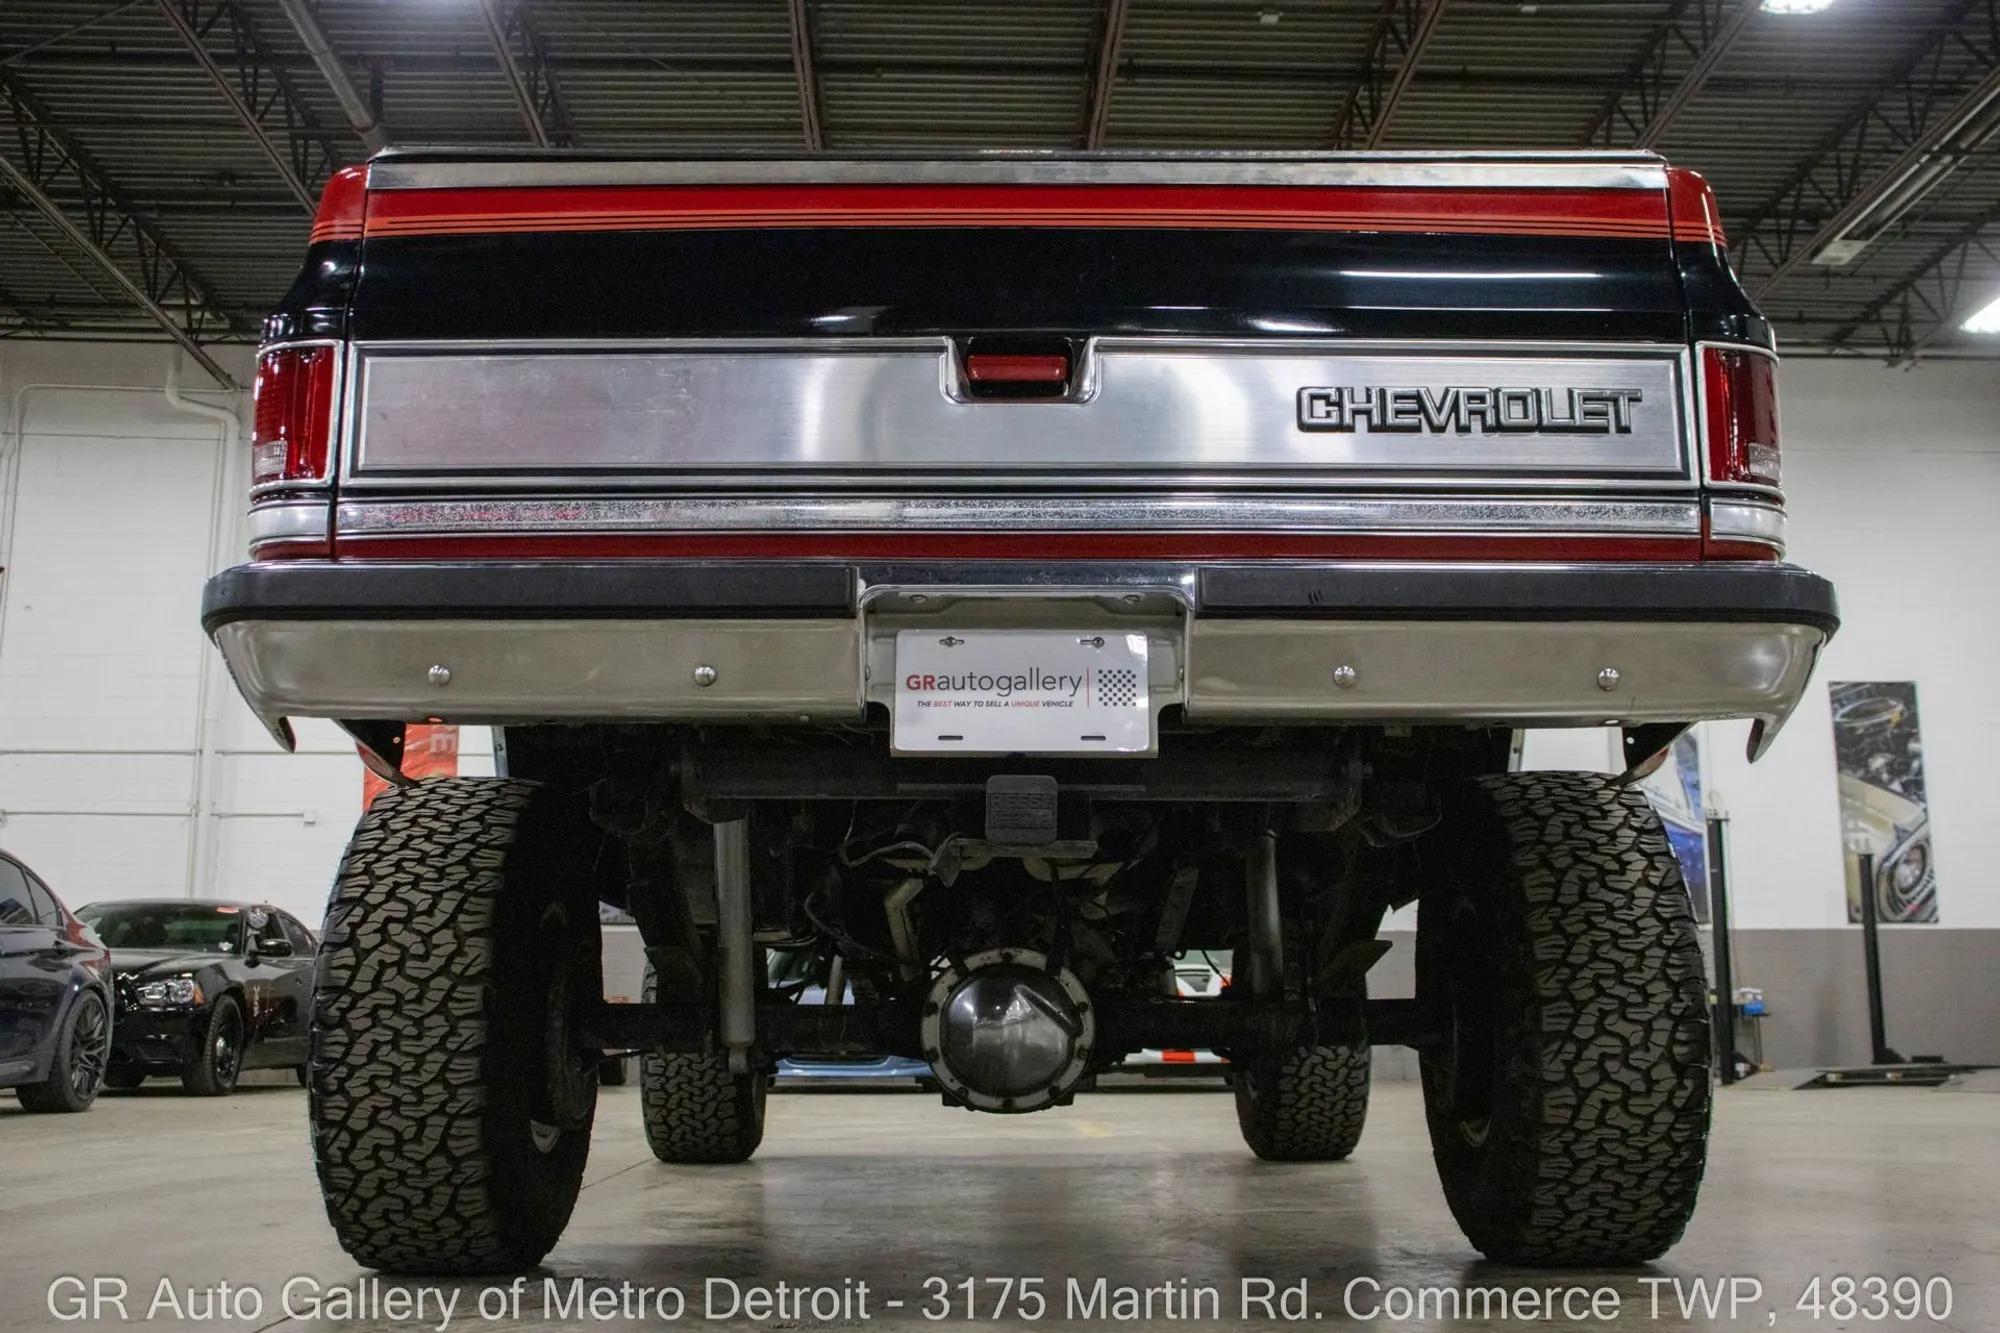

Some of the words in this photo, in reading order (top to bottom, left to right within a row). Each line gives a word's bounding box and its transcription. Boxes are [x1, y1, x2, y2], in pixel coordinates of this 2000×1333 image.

[1296, 386, 1643, 434] CHEVROLET
[906, 667, 1083, 697] GRautogallery
[917, 699, 932, 709] THE
[933, 699, 952, 709] BEST
[954, 699, 972, 709] WAY
[974, 699, 985, 709] TO
[985, 699, 1001, 709] SELL
[1003, 699, 1010, 709] A
[1011, 699, 1040, 709] UNIQUE
[1042, 699, 1074, 709] VEHICLE
